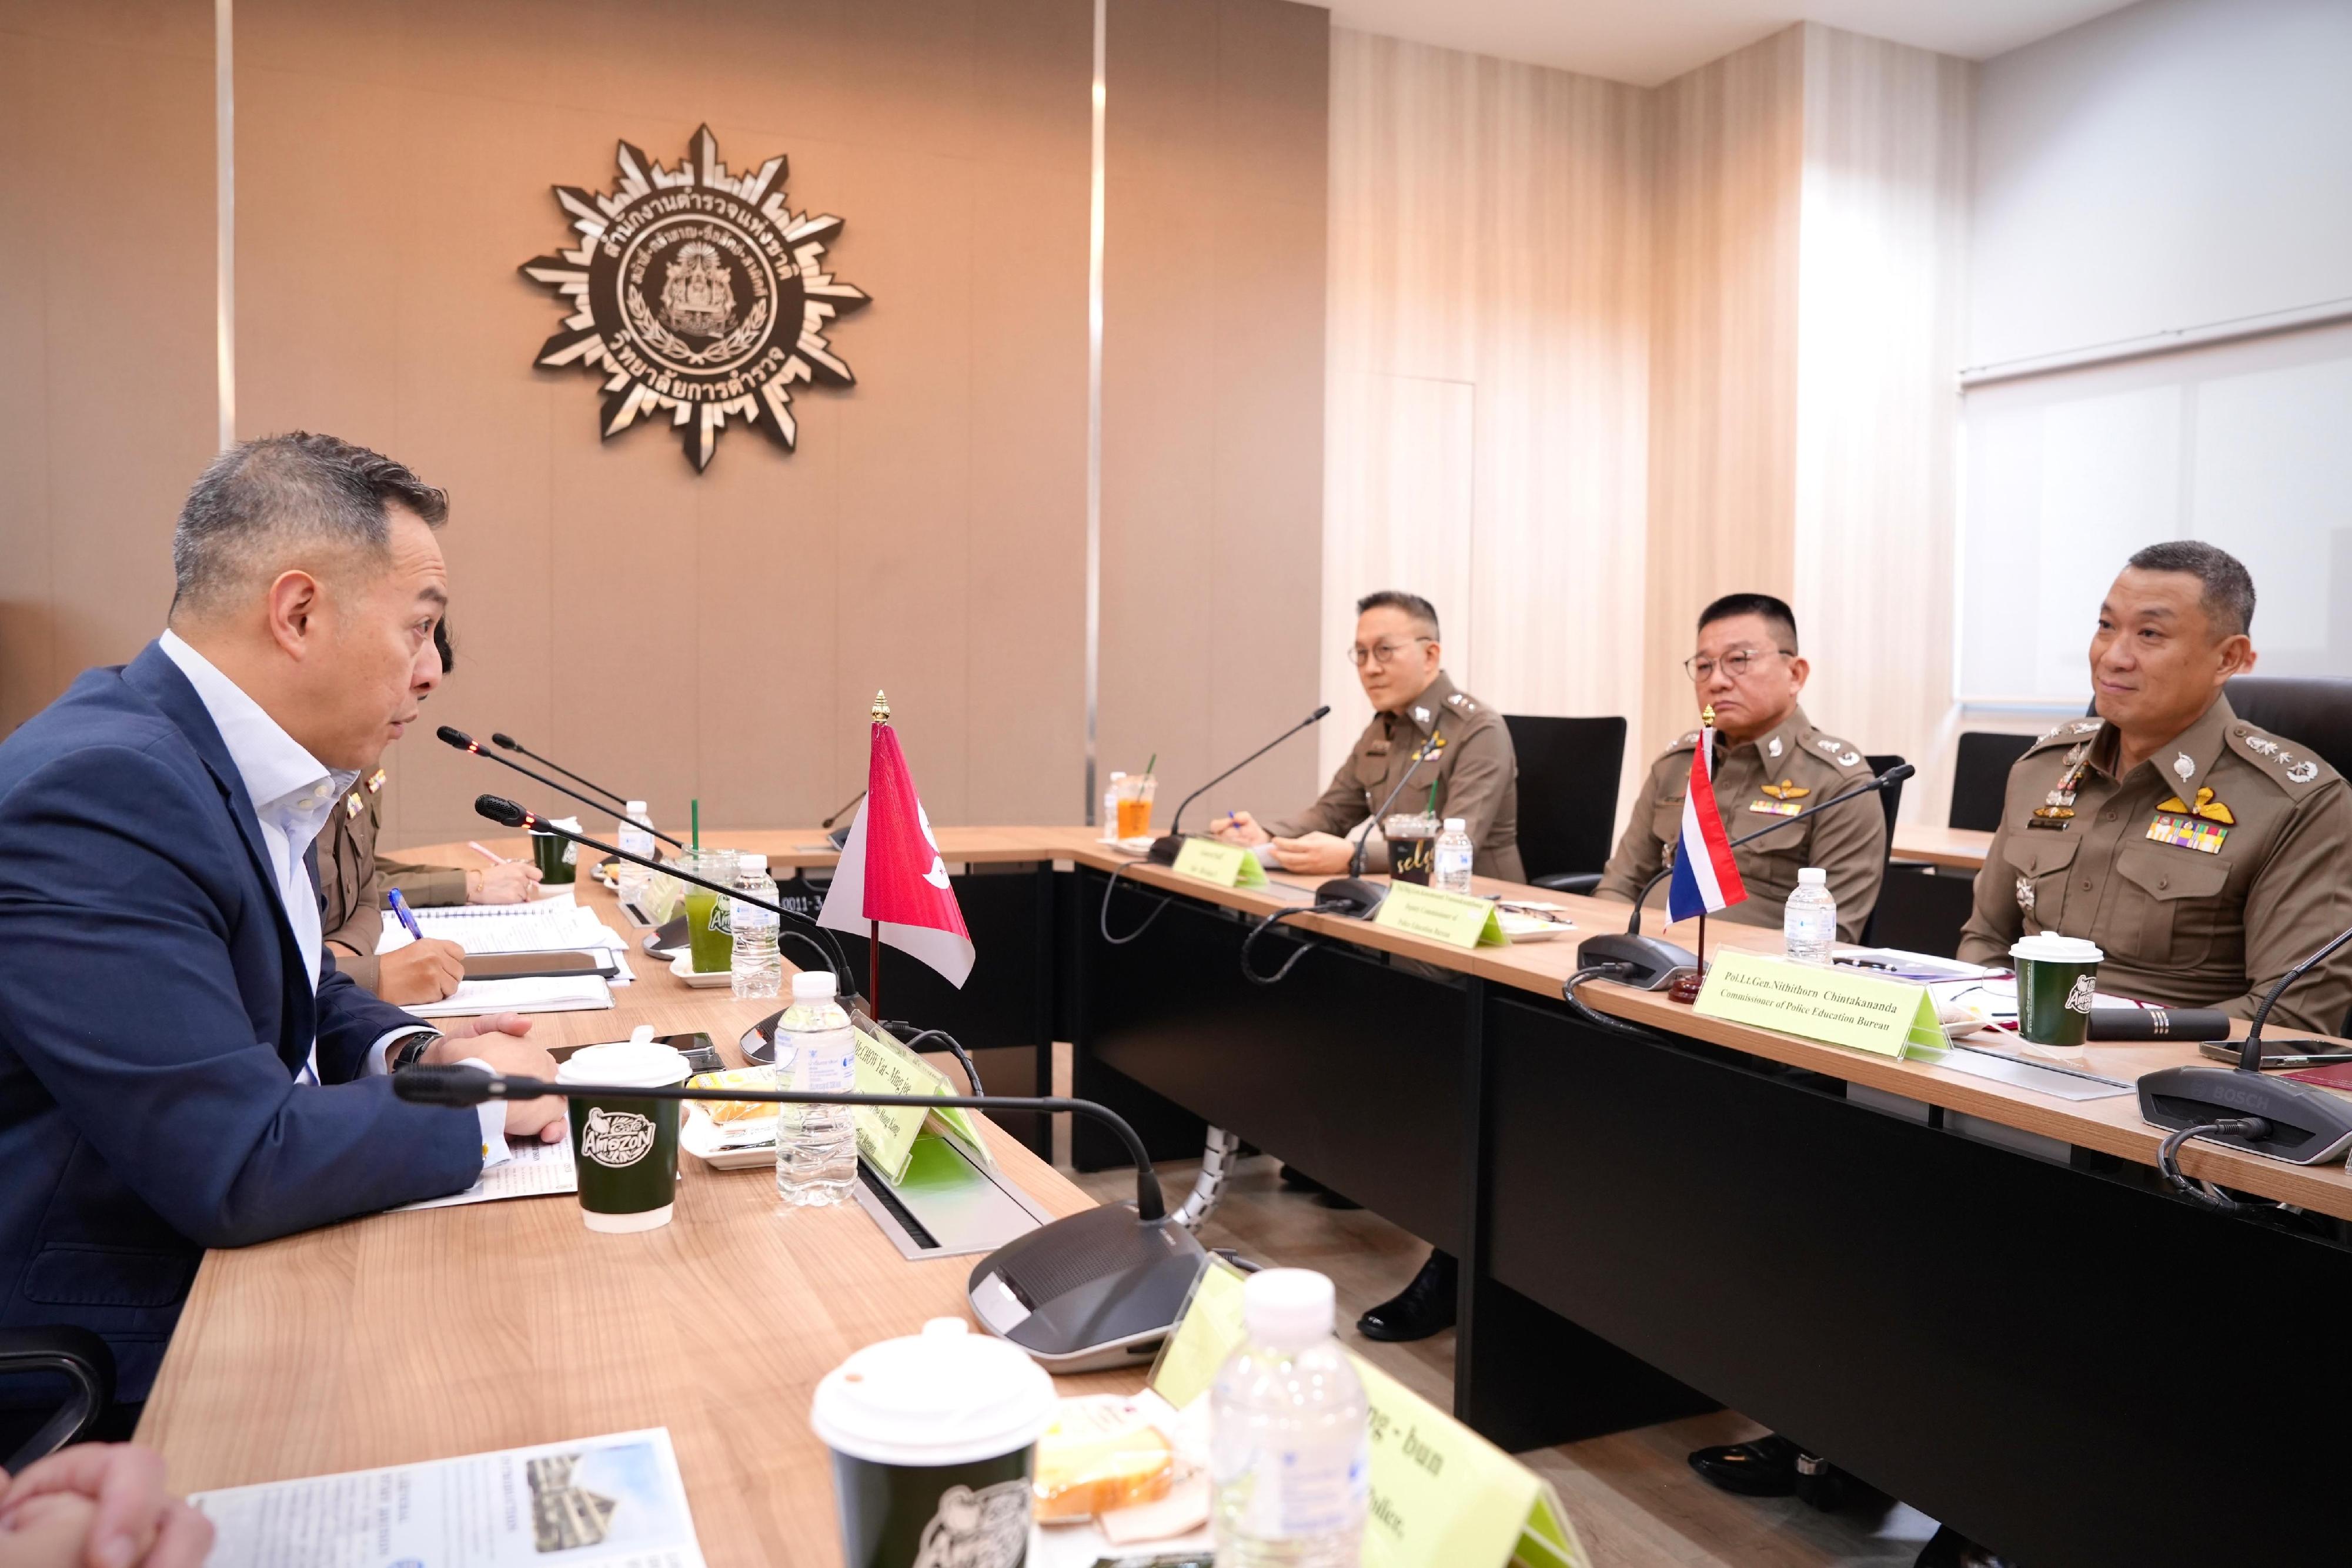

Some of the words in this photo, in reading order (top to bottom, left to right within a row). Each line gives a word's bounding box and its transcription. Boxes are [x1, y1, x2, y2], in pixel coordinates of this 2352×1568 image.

[601, 186, 800, 281] สำนักงานตำรวจแห่งชาติ
[609, 329, 786, 401] วิทยาลัยการตำรวจ
[1720, 988, 1775, 1007] Commissioner
[1776, 1001, 1786, 1009] of
[1786, 1001, 1810, 1015] Police
[1812, 1007, 1855, 1024] Education
[1857, 1016, 1890, 1031] Bureau
[1823, 990, 1897, 1014] Chintakananda
[876, 1058, 888, 1076] Yat
[888, 1067, 904, 1094] Ming
[2212, 1086, 2270, 1111] BOSCH
[1402, 1423, 1445, 1477] bun
